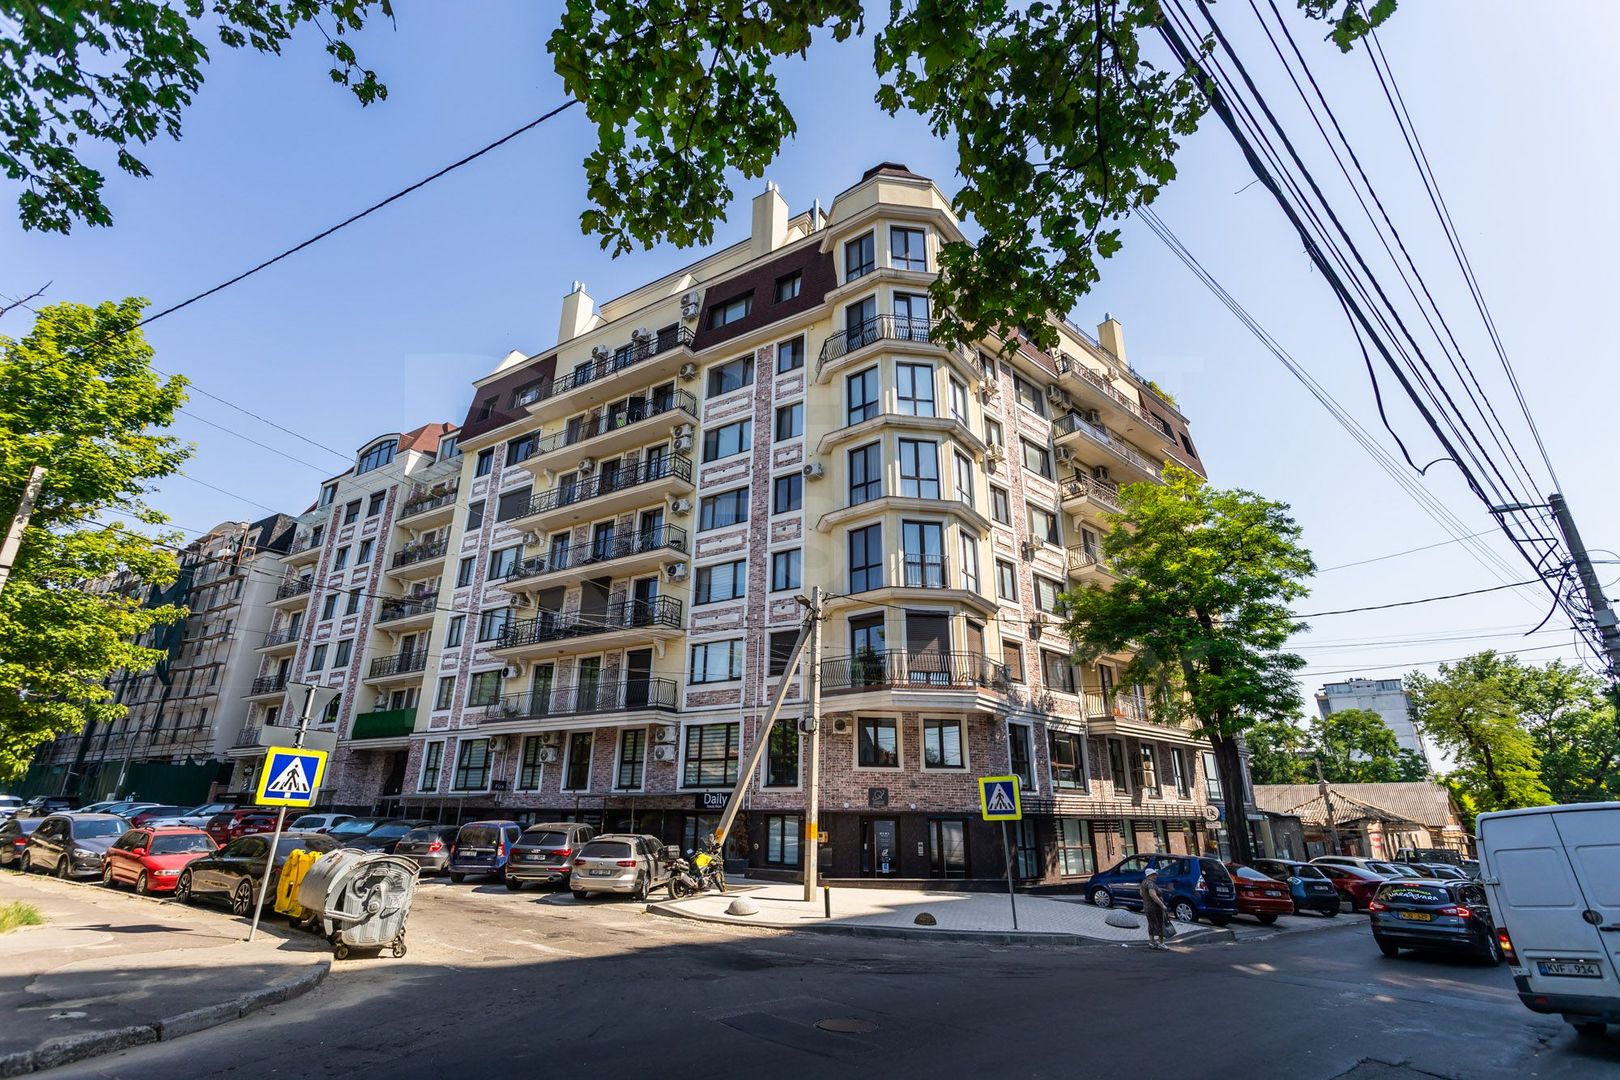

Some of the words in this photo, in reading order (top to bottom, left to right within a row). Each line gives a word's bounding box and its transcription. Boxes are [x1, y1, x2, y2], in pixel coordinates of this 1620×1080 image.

[704, 793, 728, 807] Daily
[1547, 963, 1566, 973] KVF
[1574, 965, 1594, 974] 914
